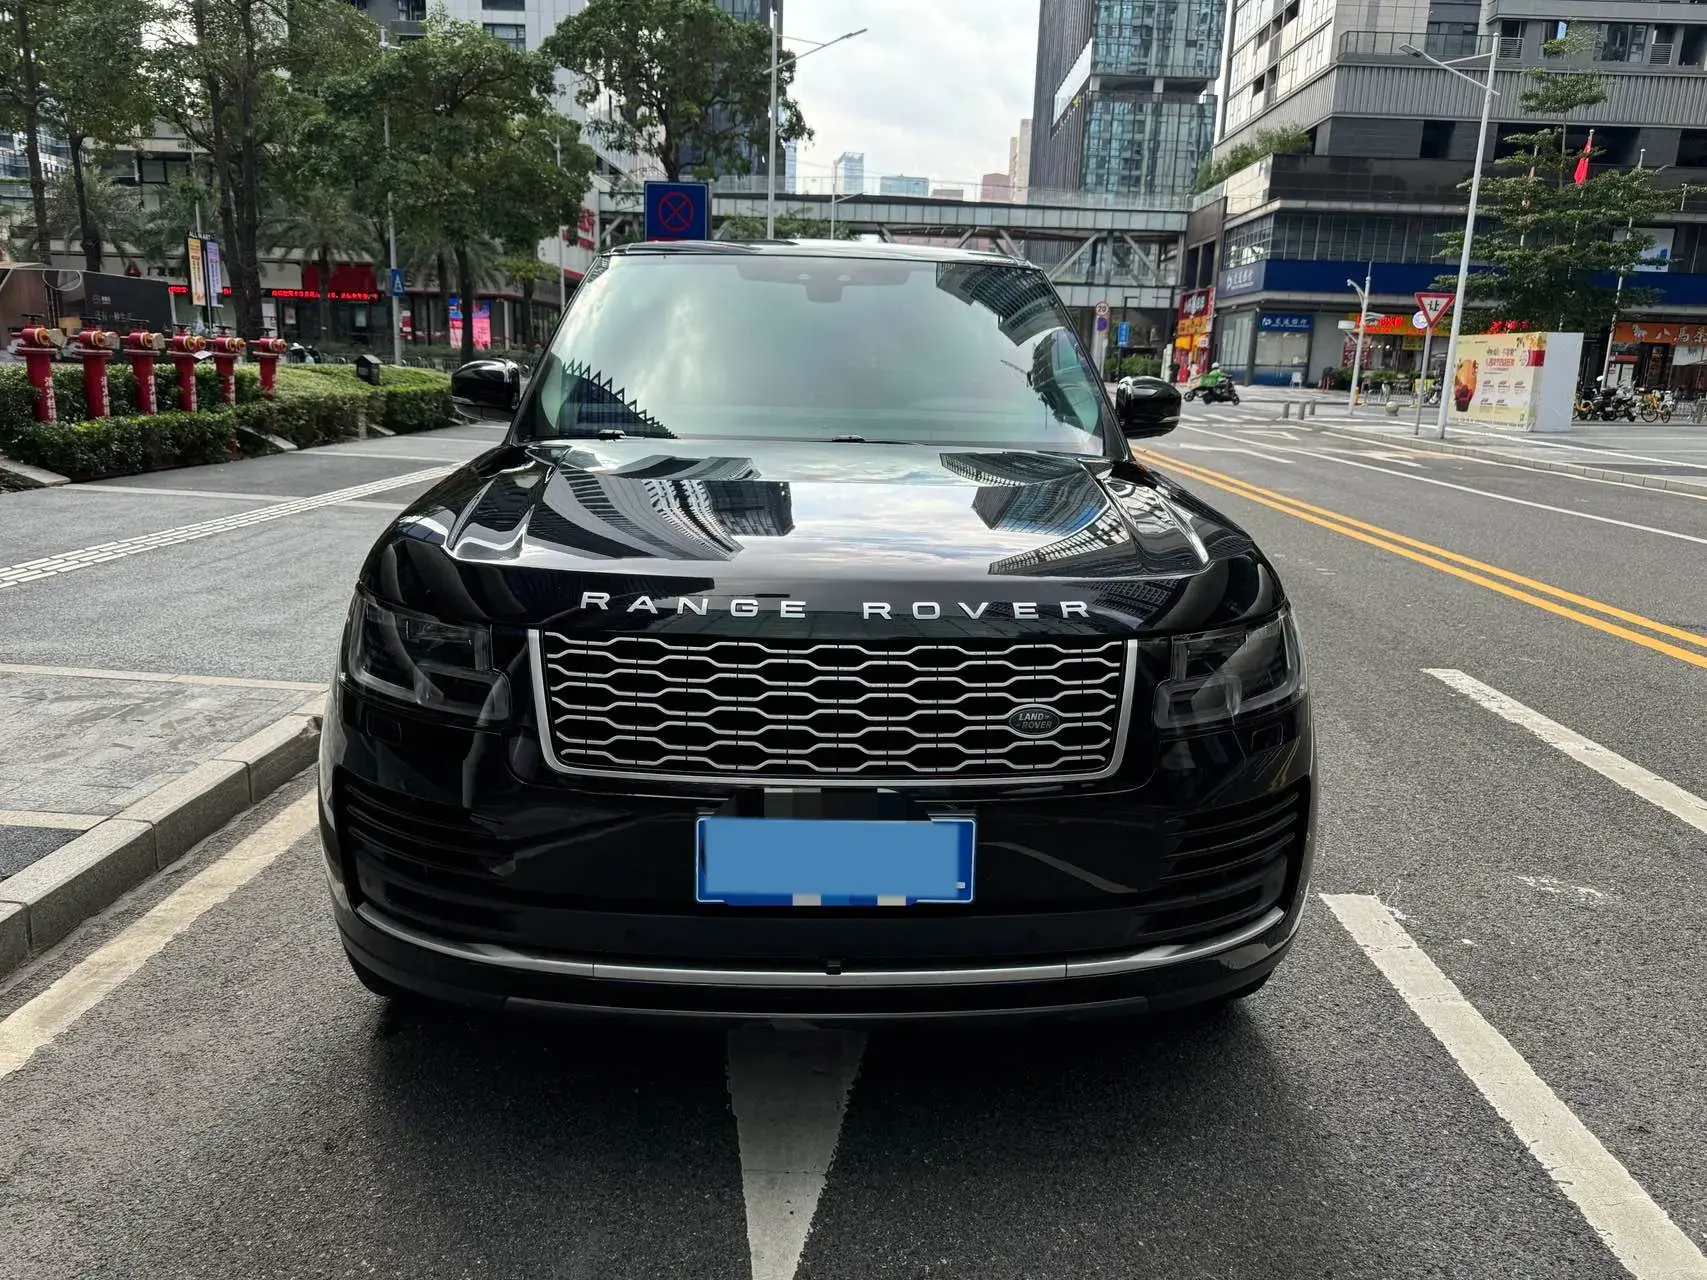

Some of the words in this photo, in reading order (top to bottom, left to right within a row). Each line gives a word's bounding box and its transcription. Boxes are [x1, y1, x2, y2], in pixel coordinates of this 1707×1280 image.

[1097, 305, 1106, 313] 20
[1428, 300, 1440, 311] 让
[580, 591, 806, 618] RANGE
[862, 600, 1090, 620] ROVER
[1018, 712, 1045, 721] LAND
[1021, 720, 1053, 729] ROVER
